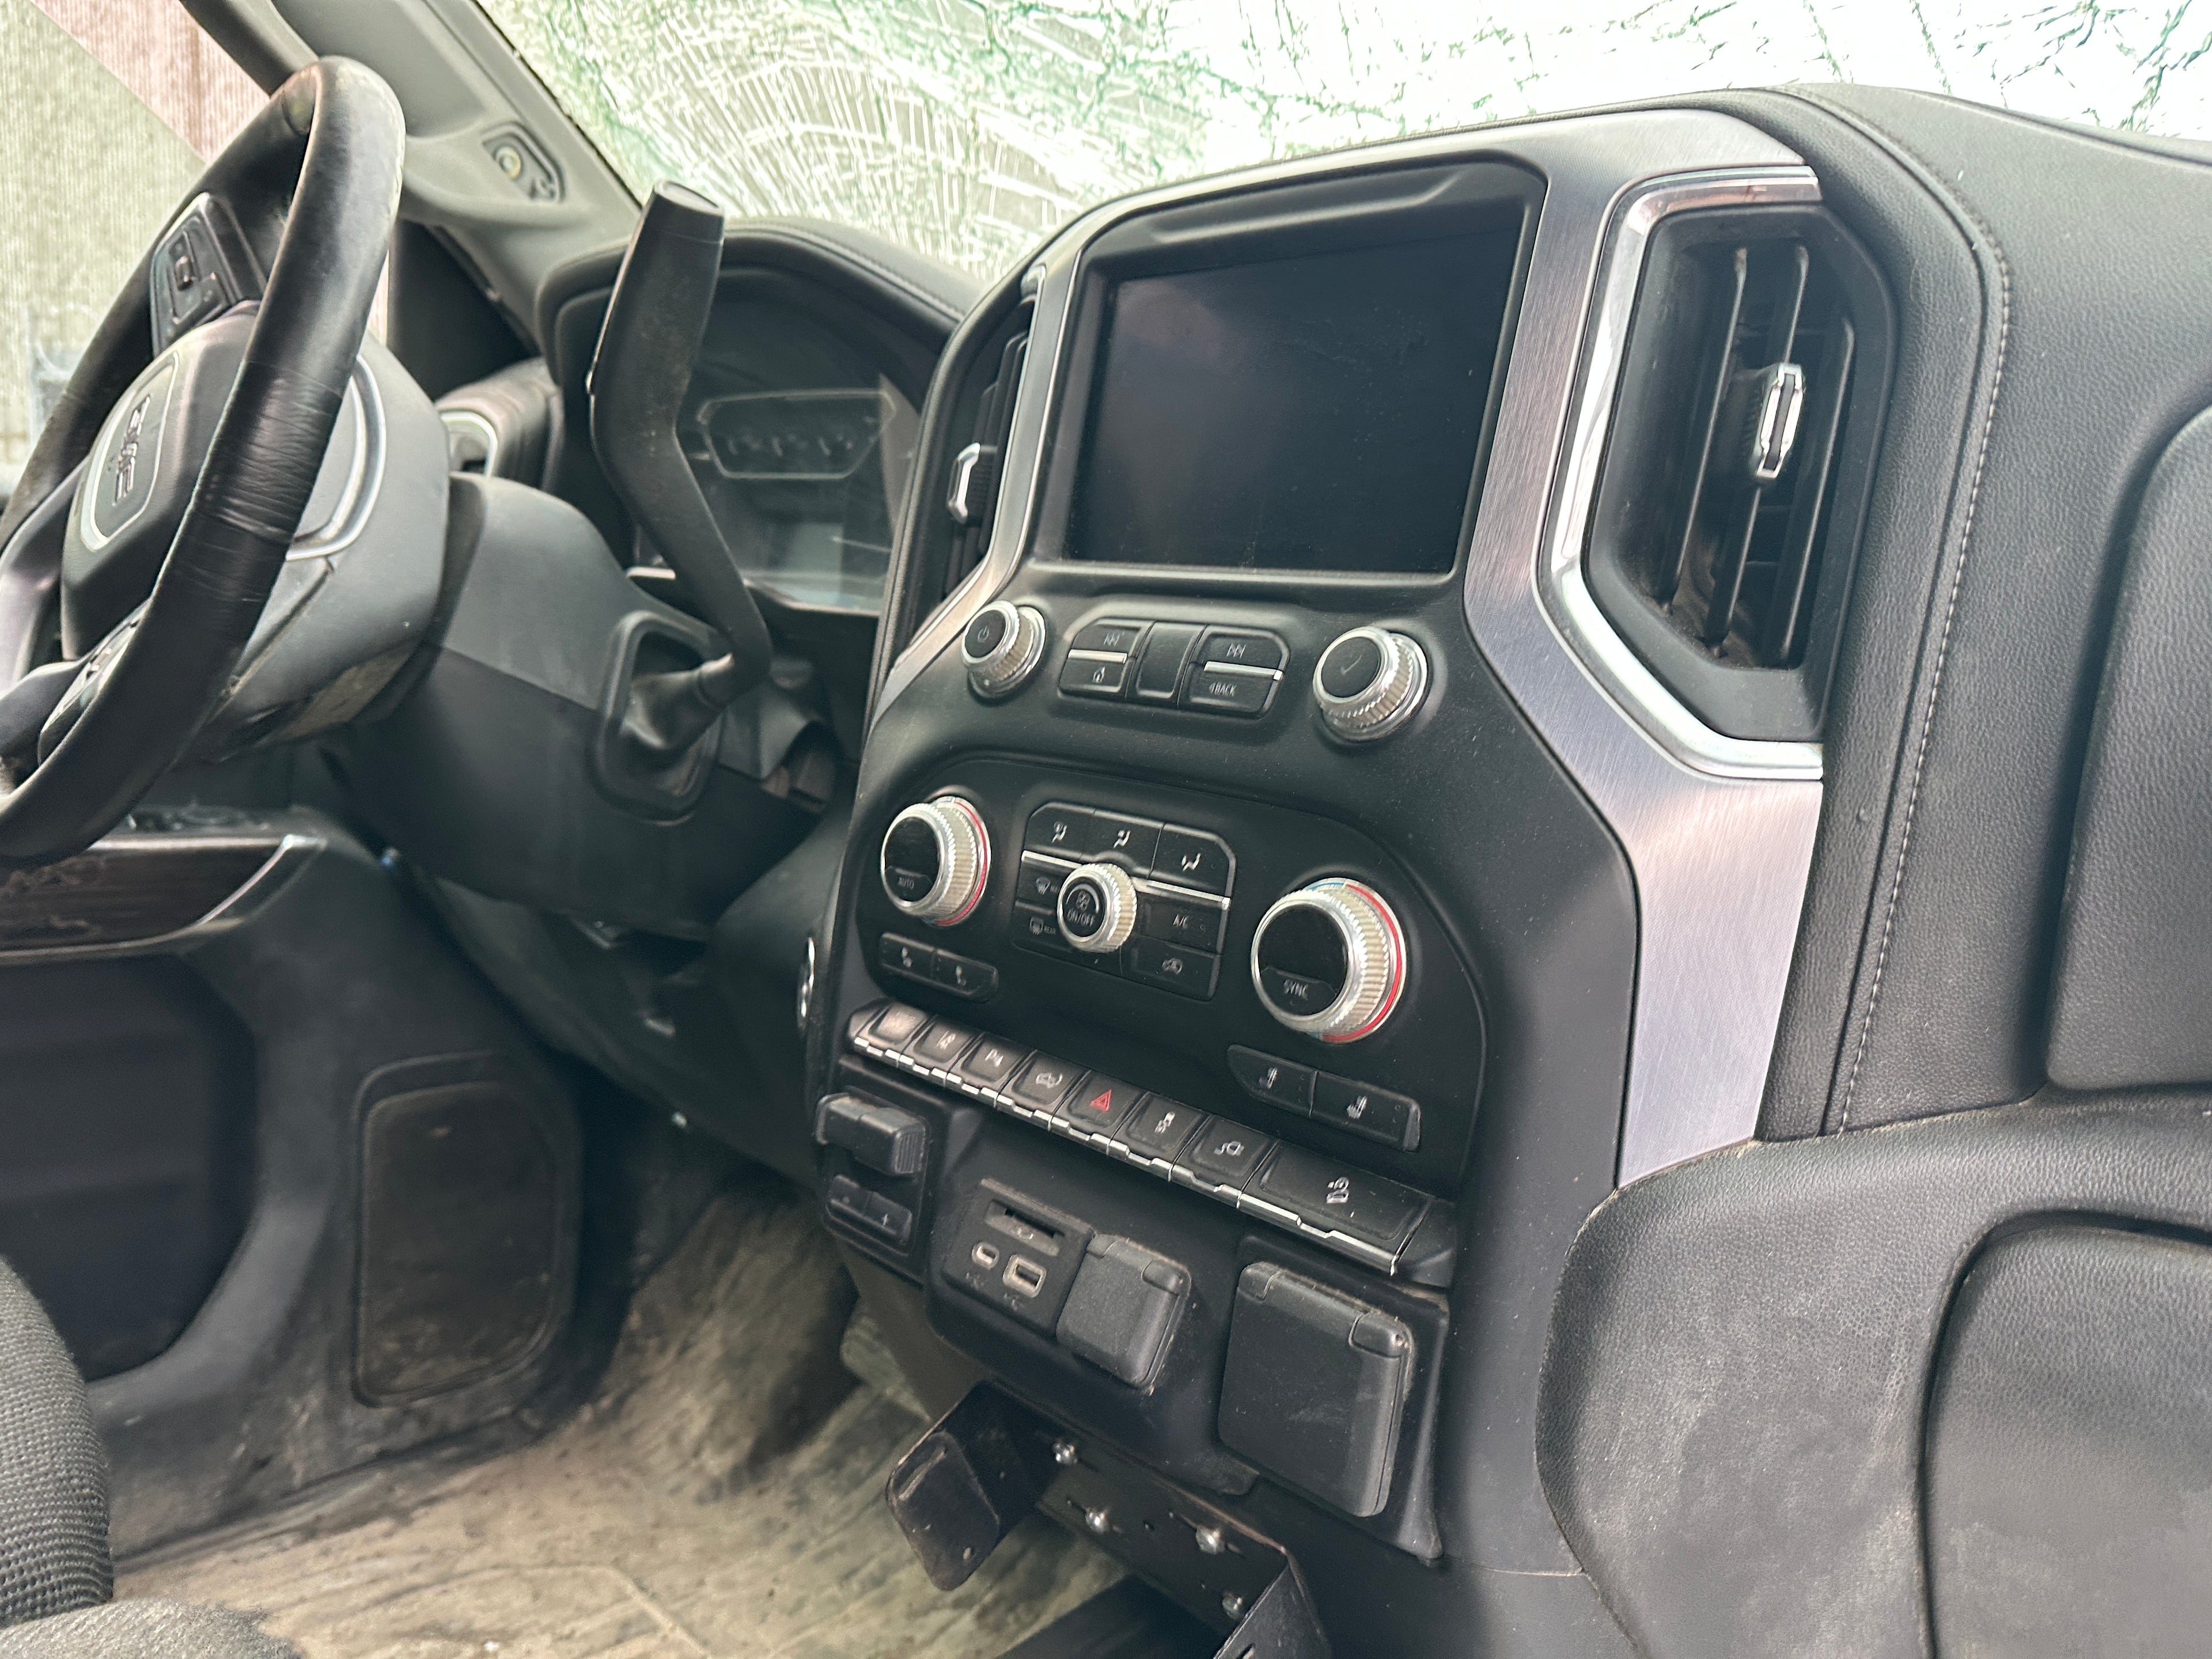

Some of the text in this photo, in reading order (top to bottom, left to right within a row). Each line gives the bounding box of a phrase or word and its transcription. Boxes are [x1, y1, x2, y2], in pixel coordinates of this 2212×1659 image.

[1214, 683, 1237, 696] BACK
[898, 876, 914, 889] AUTO
[1067, 908, 1094, 927] ON/OFF
[1173, 914, 1189, 929] A/C
[1283, 979, 1309, 1001] SYNC
